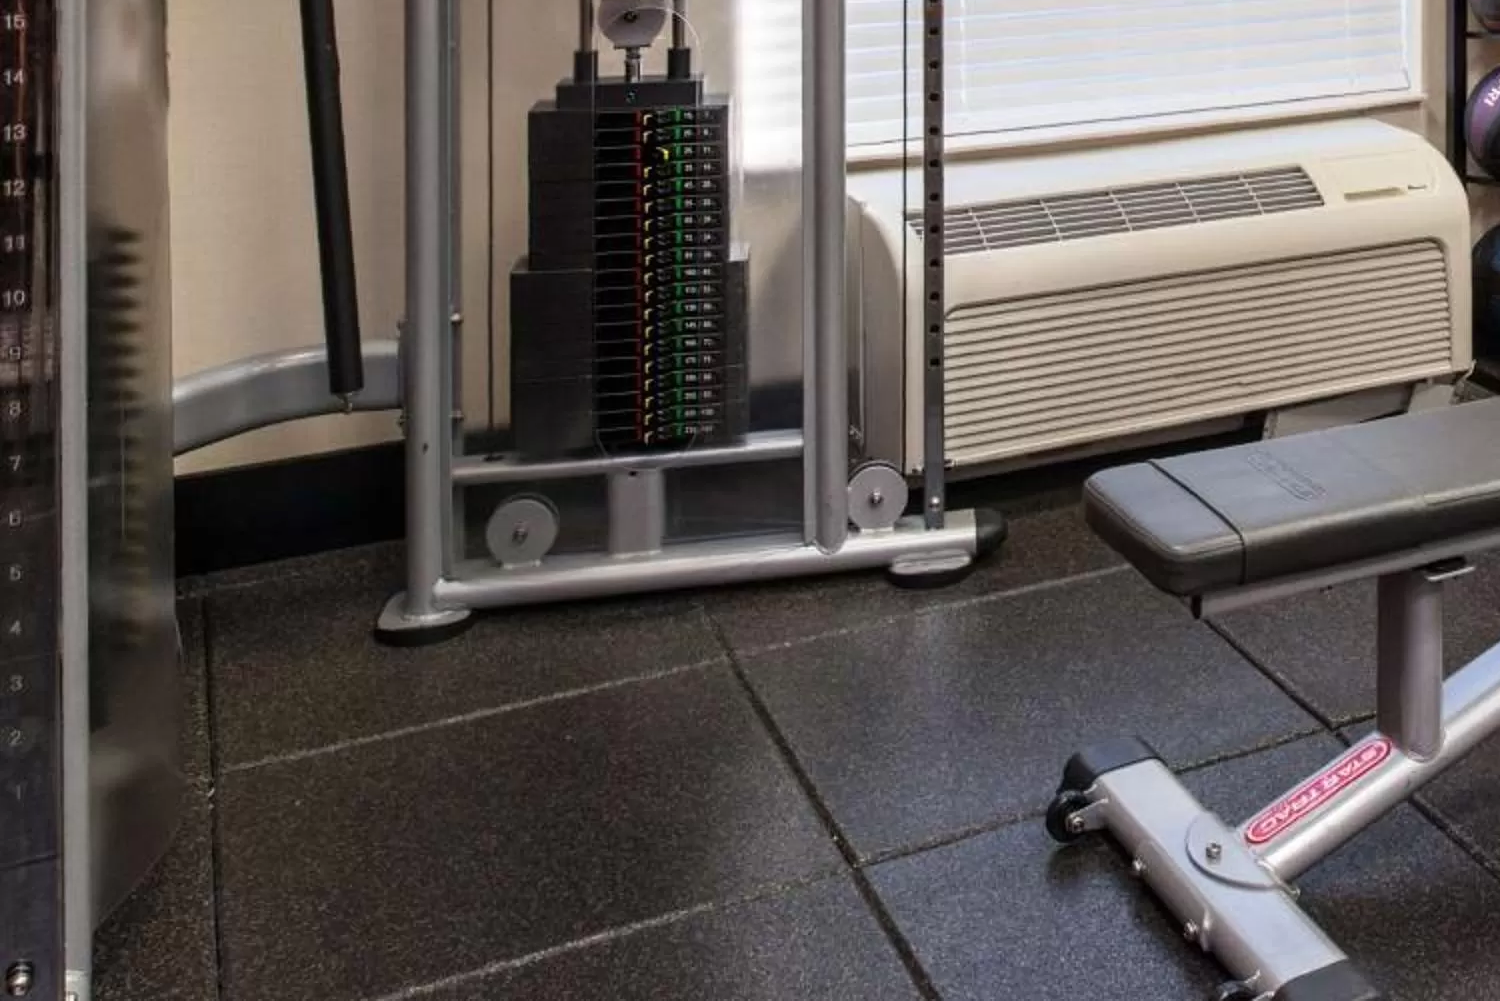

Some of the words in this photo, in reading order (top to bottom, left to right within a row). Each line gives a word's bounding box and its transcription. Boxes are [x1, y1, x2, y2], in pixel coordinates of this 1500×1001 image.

[4, 13, 26, 30] 15
[4, 68, 25, 85] 14
[4, 123, 26, 141] 13
[3, 179, 26, 196] 12
[4, 234, 25, 251] 11
[4, 289, 25, 306] 10
[9, 345, 21, 360] 9
[9, 400, 21, 417] 8
[9, 454, 21, 472] 7
[9, 619, 22, 636] 4
[9, 674, 23, 691] 3
[9, 729, 21, 745] 2
